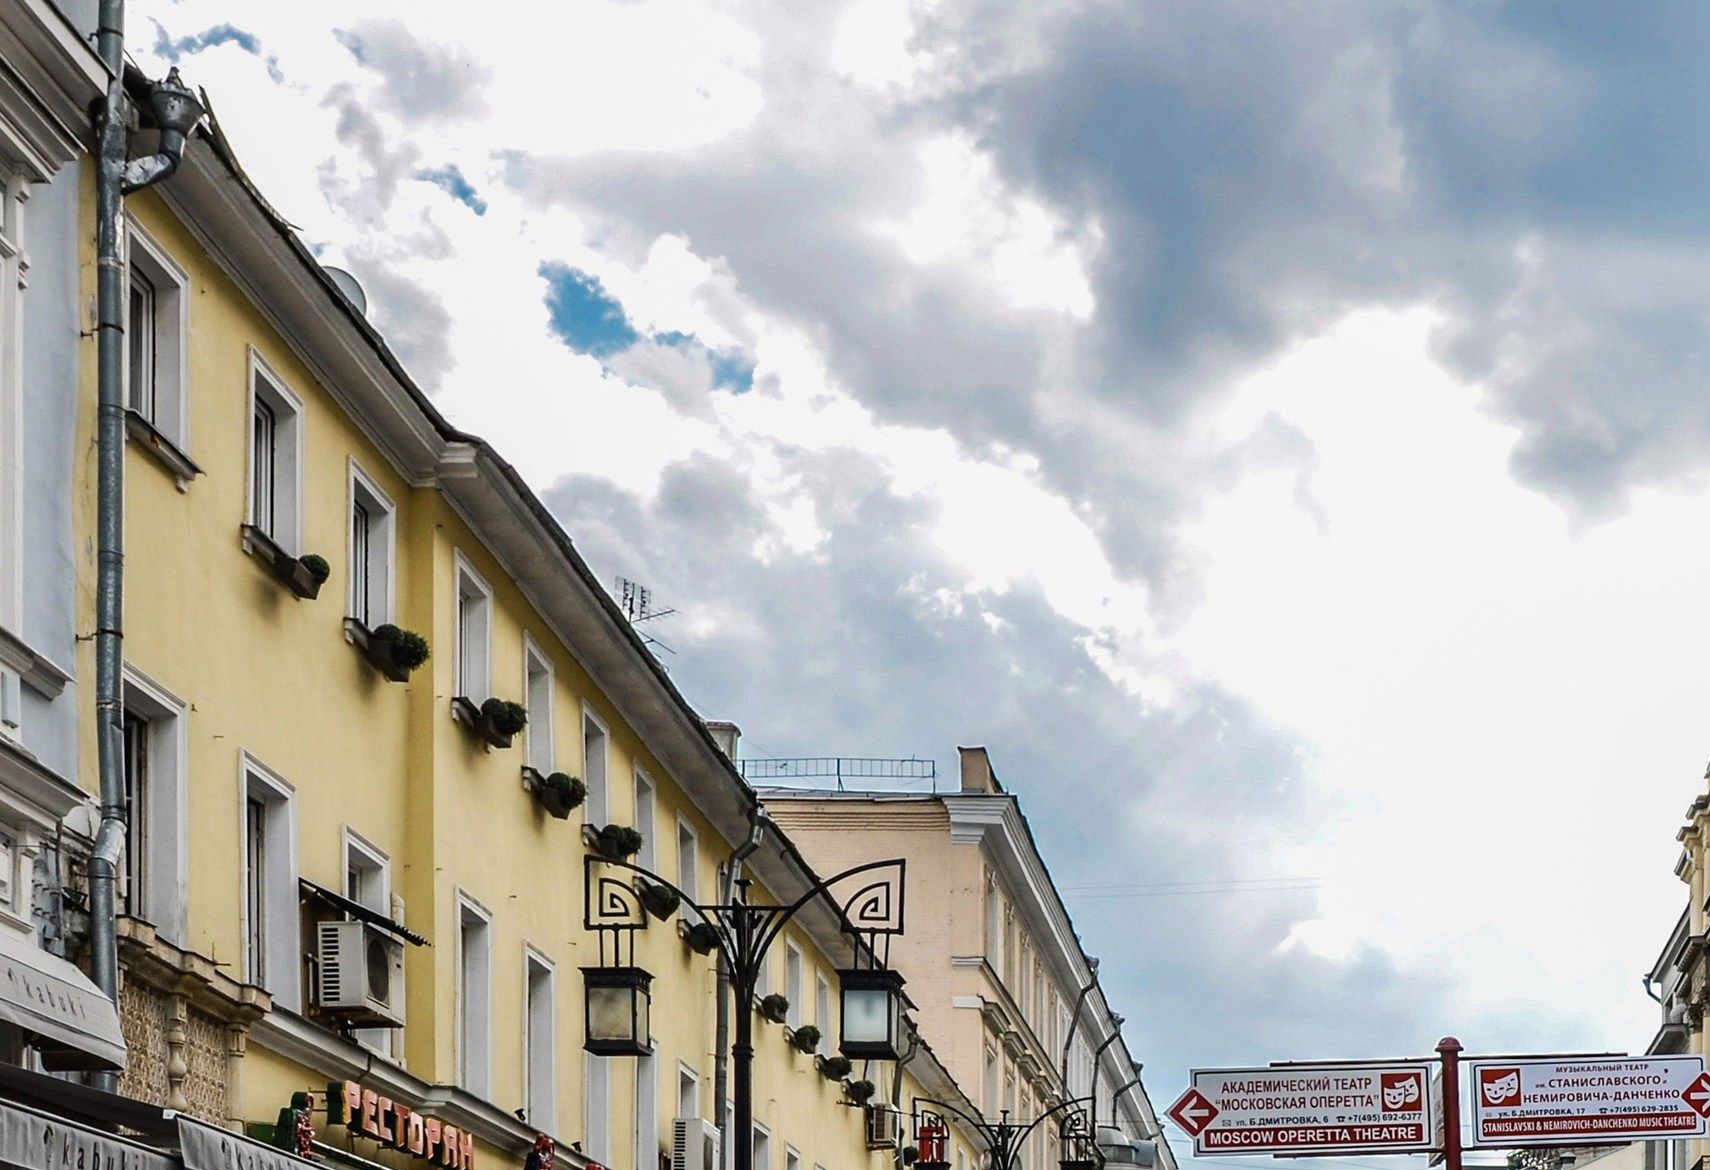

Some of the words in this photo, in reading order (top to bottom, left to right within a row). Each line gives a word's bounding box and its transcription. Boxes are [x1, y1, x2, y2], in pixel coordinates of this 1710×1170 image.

[22, 974, 86, 1019] kabuki
[1556, 1064, 1622, 1073] МУЗЫКАЛЬНЫЙ
[1221, 1077, 1330, 1095] АКАДЕМИЧЕСКИЙ
[1334, 1077, 1372, 1090] ТЕАТР
[1548, 1075, 1661, 1088] СТАНИСЛАВСКОГО
[1523, 1089, 1680, 1104] НЕМИРОВИЧА-ДАНЧЕНКО
[1641, 1105, 1679, 1113] 629-2835
[1323, 1115, 1329, 1123] 6
[1382, 1113, 1422, 1121] 692-6377
[1483, 1122, 1535, 1133] STANISLAVSKI
[1536, 1122, 1543, 1131] &
[1639, 1117, 1662, 1127] MUSIC
[1663, 1115, 1696, 1126] THEATRE
[1210, 1131, 1274, 1145] MOSCOW
[1277, 1128, 1351, 1143] OPERETTA
[1353, 1126, 1417, 1140] THEATRE
